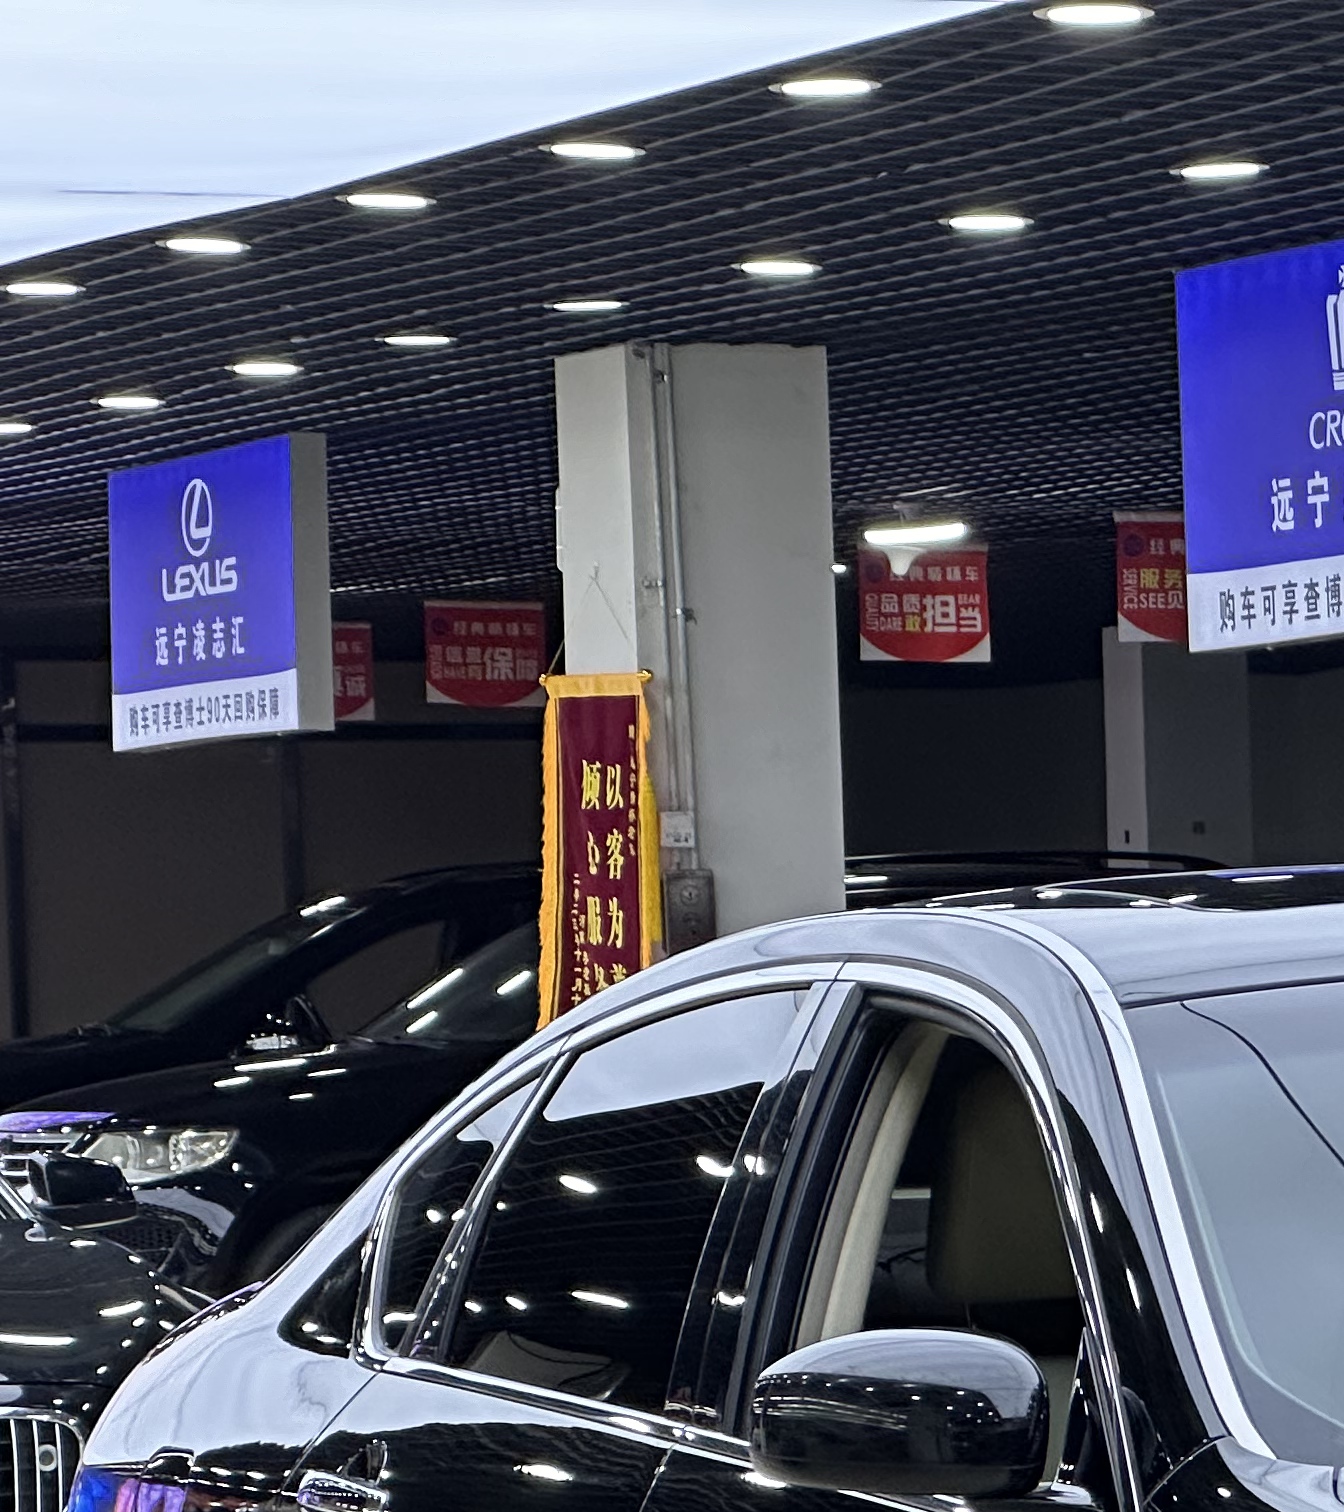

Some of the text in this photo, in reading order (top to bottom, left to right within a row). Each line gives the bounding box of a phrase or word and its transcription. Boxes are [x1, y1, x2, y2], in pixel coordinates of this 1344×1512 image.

[161, 555, 238, 602] LEXUS
[1139, 567, 1184, 590] 服务
[155, 616, 246, 666] 远宁凌志汇
